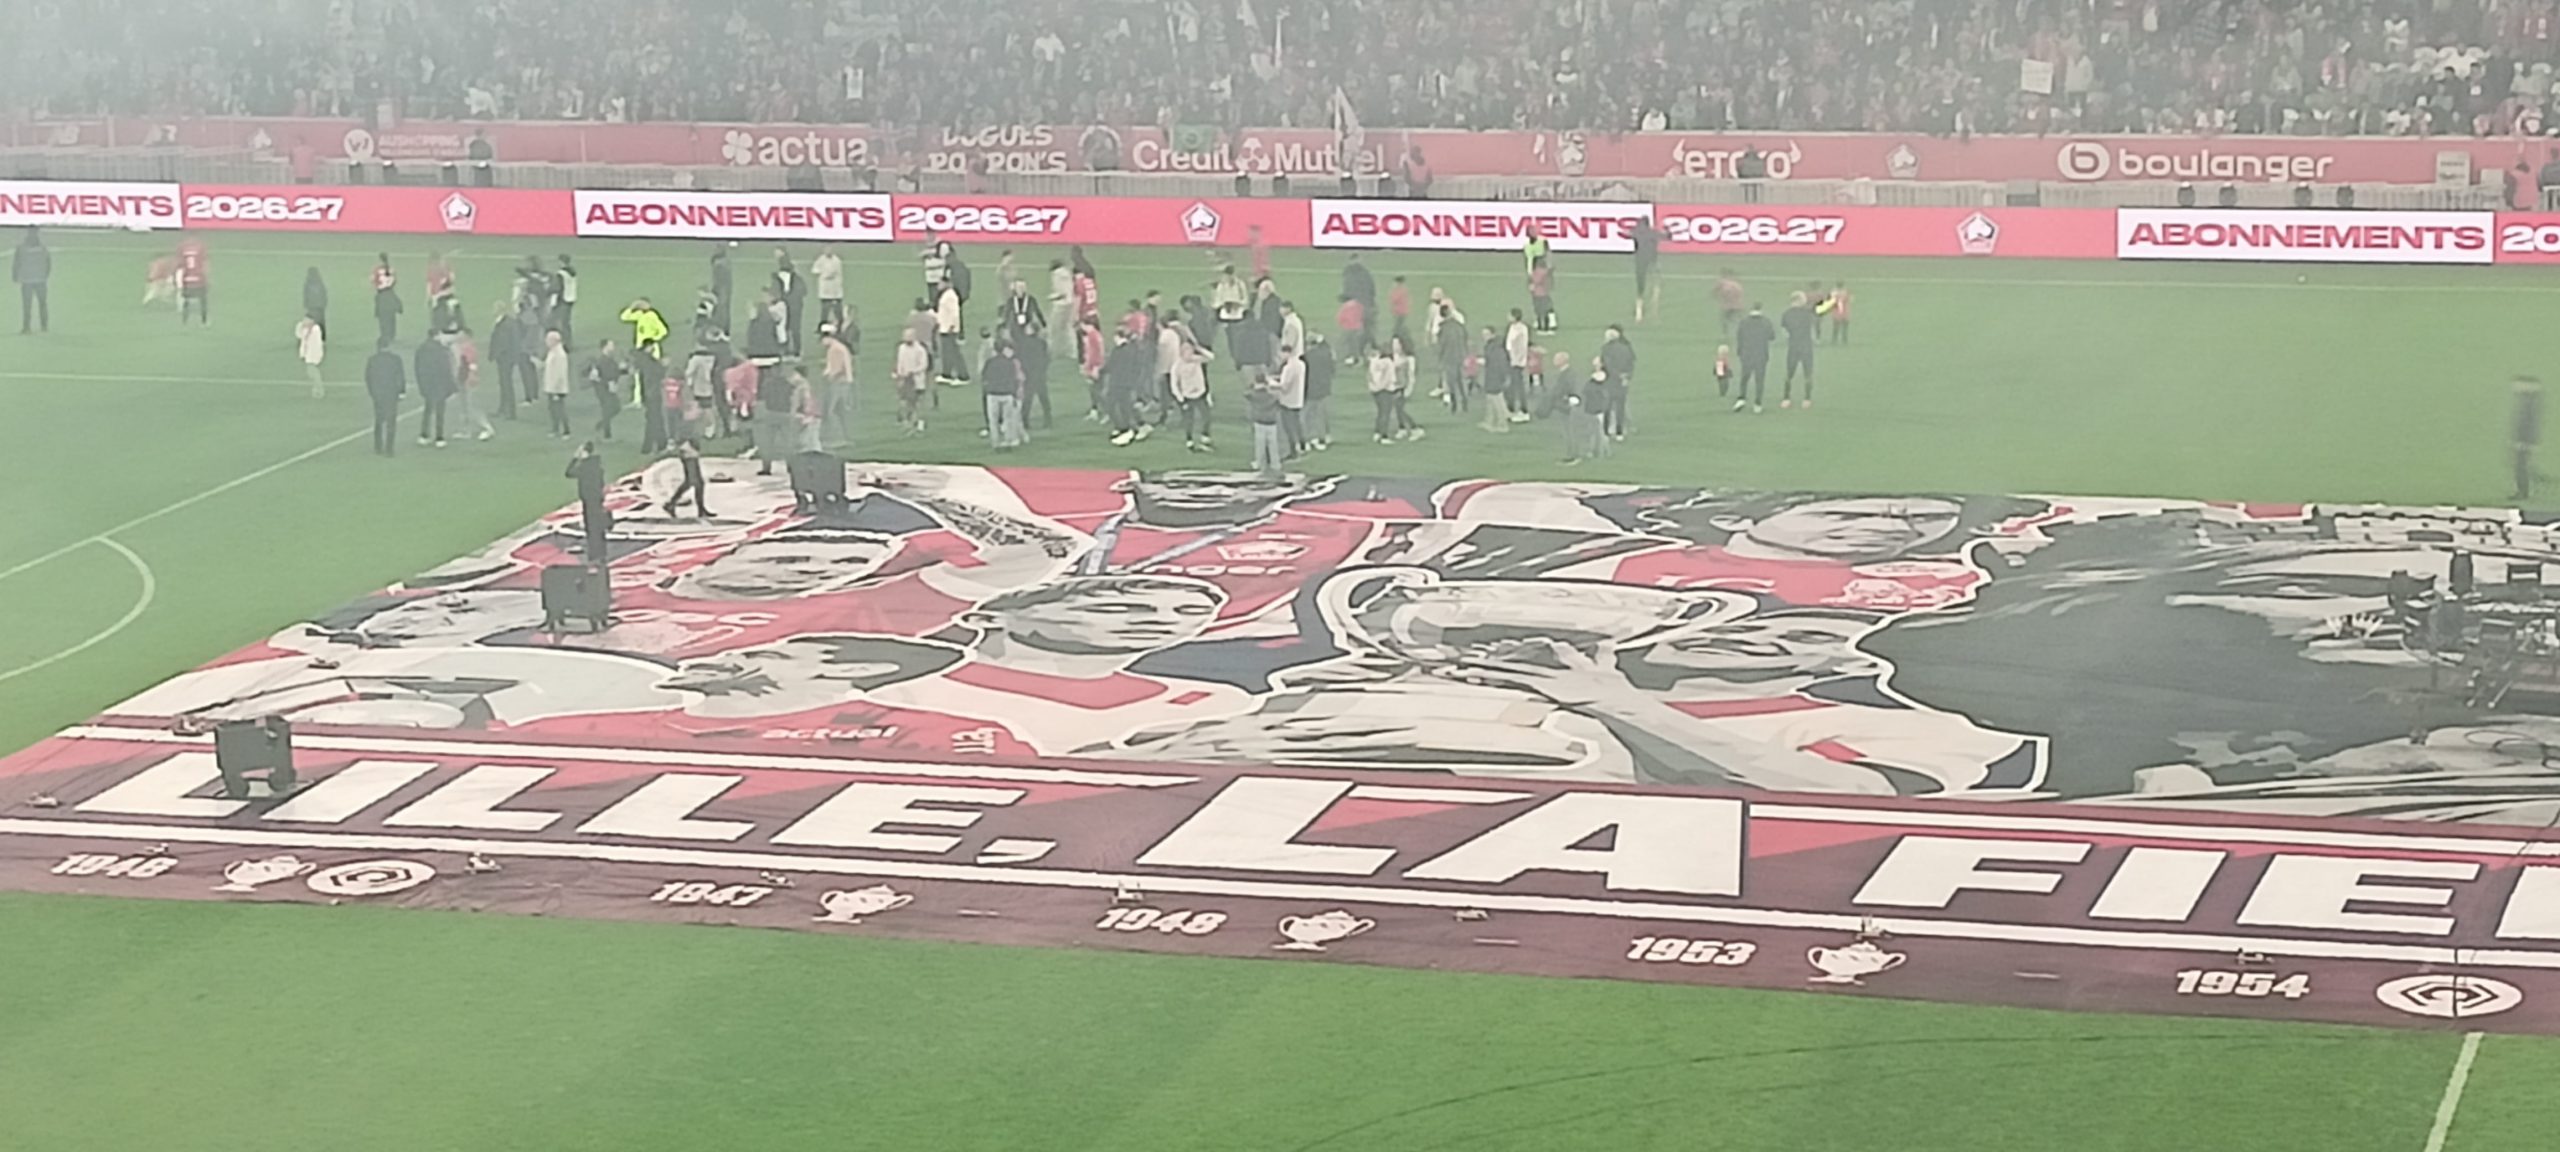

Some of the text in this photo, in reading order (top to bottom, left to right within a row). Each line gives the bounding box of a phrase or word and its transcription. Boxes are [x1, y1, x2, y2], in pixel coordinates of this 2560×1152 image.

[758, 131, 876, 165] actua
[1274, 142, 1384, 172] Mutel
[929, 152, 1067, 174] POPON'S
[2119, 149, 2333, 182] boulanger
[0, 194, 344, 221] NEMENTS 2026.27
[586, 204, 1069, 232] ABONNEMENTS 2026.27
[1321, 213, 1845, 243] ABONNEMENTS 2026.27
[2128, 223, 2485, 250] ABONNEMENTS
[74, 751, 1057, 864] LILLE,
[1135, 775, 1744, 897] LA
[1096, 907, 1228, 935] 1948
[1625, 936, 1758, 966] 1953
[2176, 970, 2310, 999] 1954
